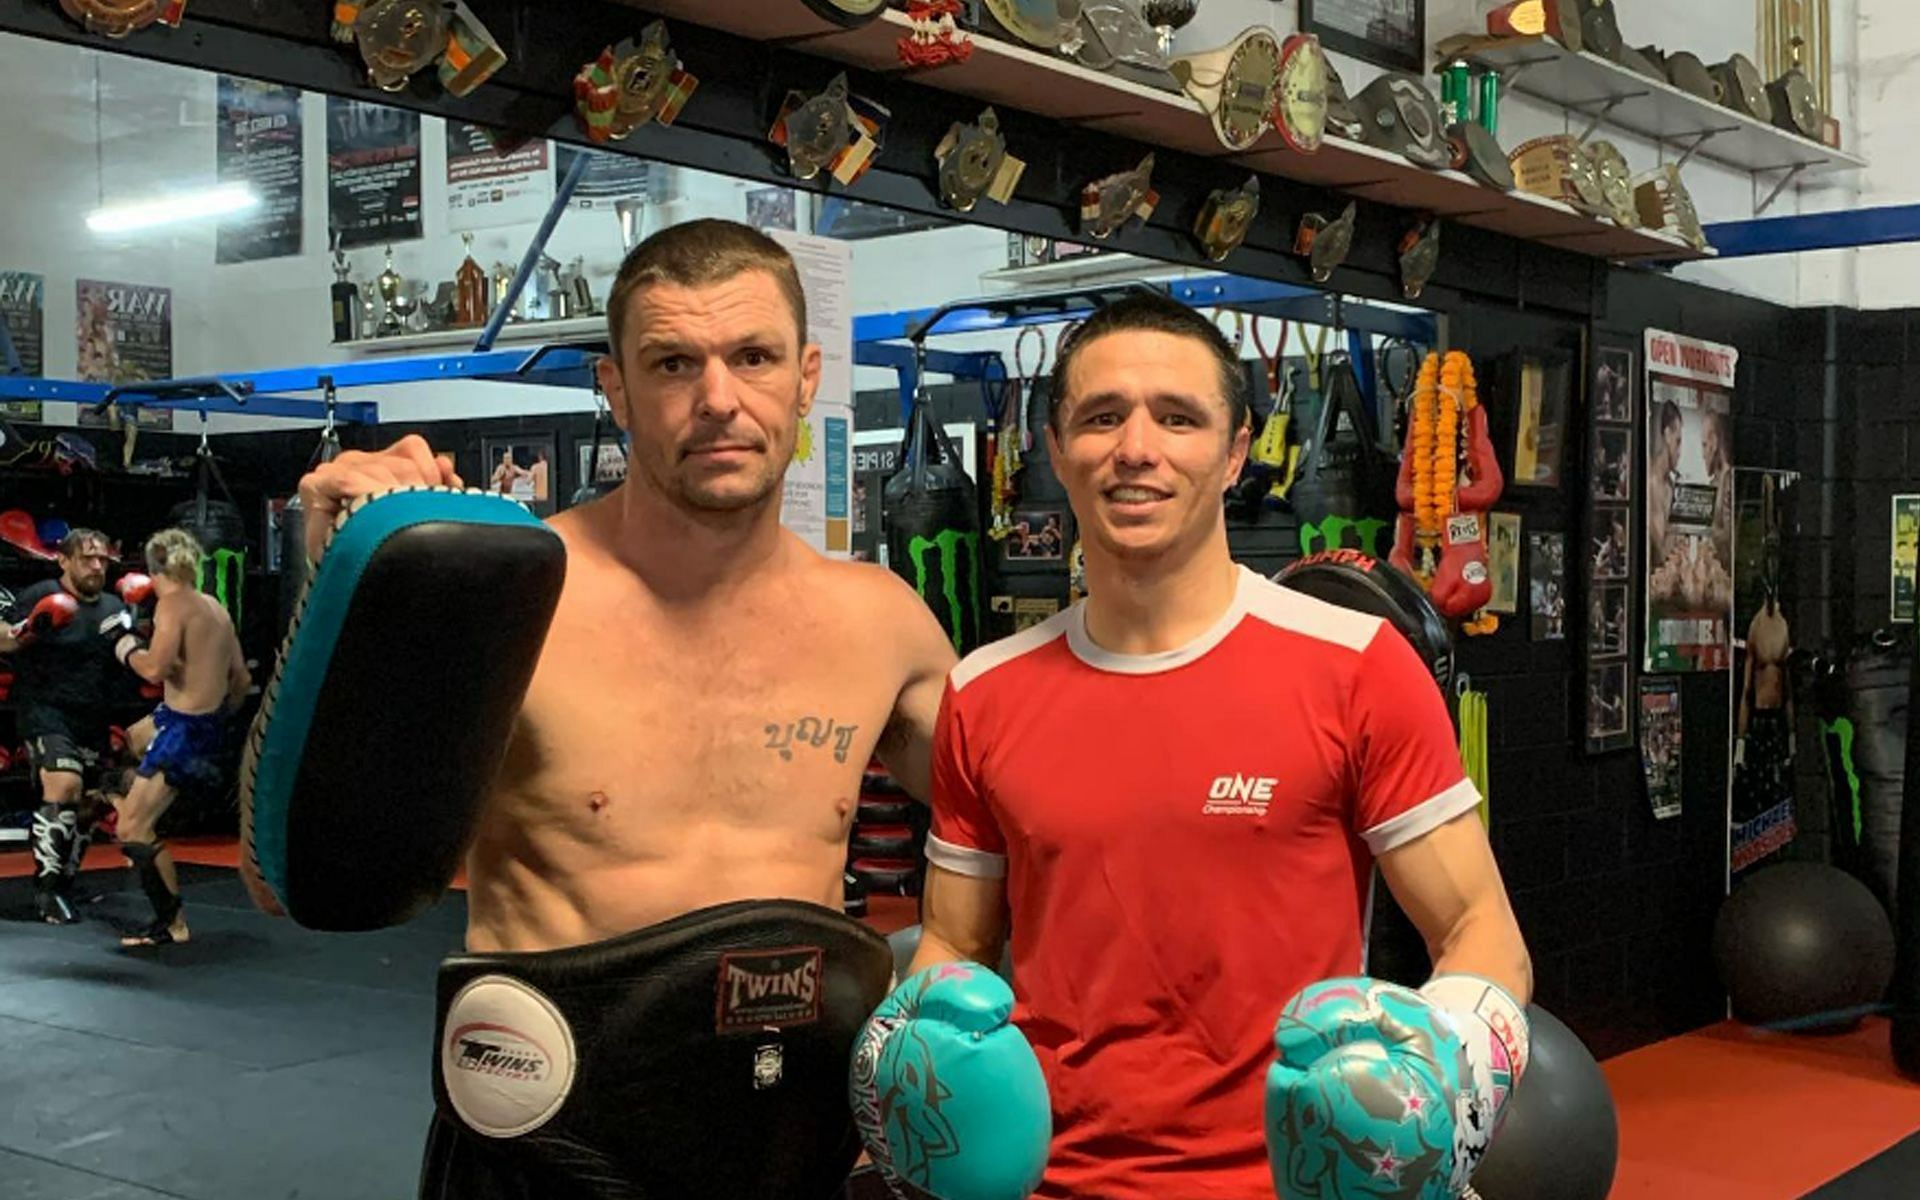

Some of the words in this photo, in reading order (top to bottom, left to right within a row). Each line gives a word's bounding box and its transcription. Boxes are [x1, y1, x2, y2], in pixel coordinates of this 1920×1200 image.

[1650, 337, 1677, 367] OPEN
[1679, 343, 1732, 379] WORKOUTS
[1209, 772, 1279, 804] ONE
[1202, 804, 1268, 817] Championship
[727, 956, 818, 1010] TWINS
[459, 1039, 544, 1073] TWINS
